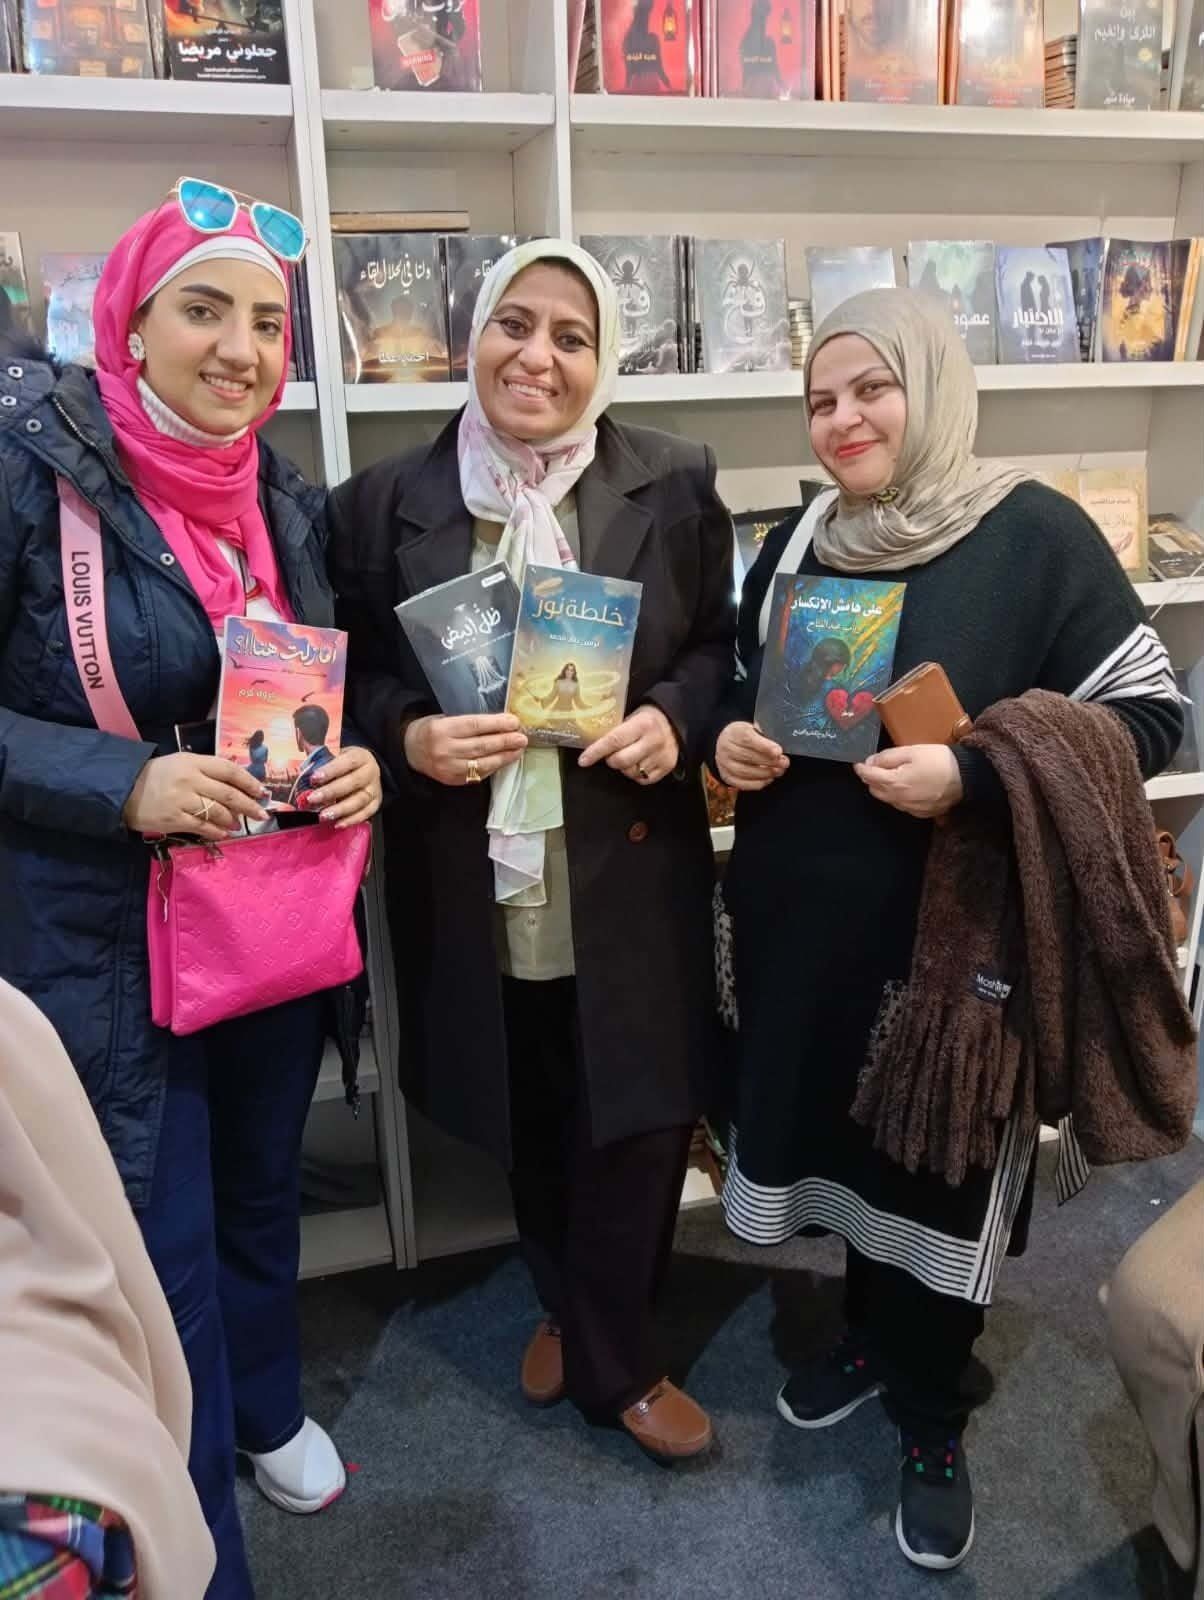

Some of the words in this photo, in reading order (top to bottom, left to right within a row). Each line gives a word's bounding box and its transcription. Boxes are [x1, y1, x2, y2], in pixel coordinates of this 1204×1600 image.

[226, 42, 278, 64] جعلوني
[71, 551, 92, 608] LOUIS
[532, 597, 565, 621] نور
[565, 601, 626, 628] خلطة
[831, 598, 862, 615] هامش
[862, 603, 884, 617] على
[76, 611, 105, 690] VUTTON
